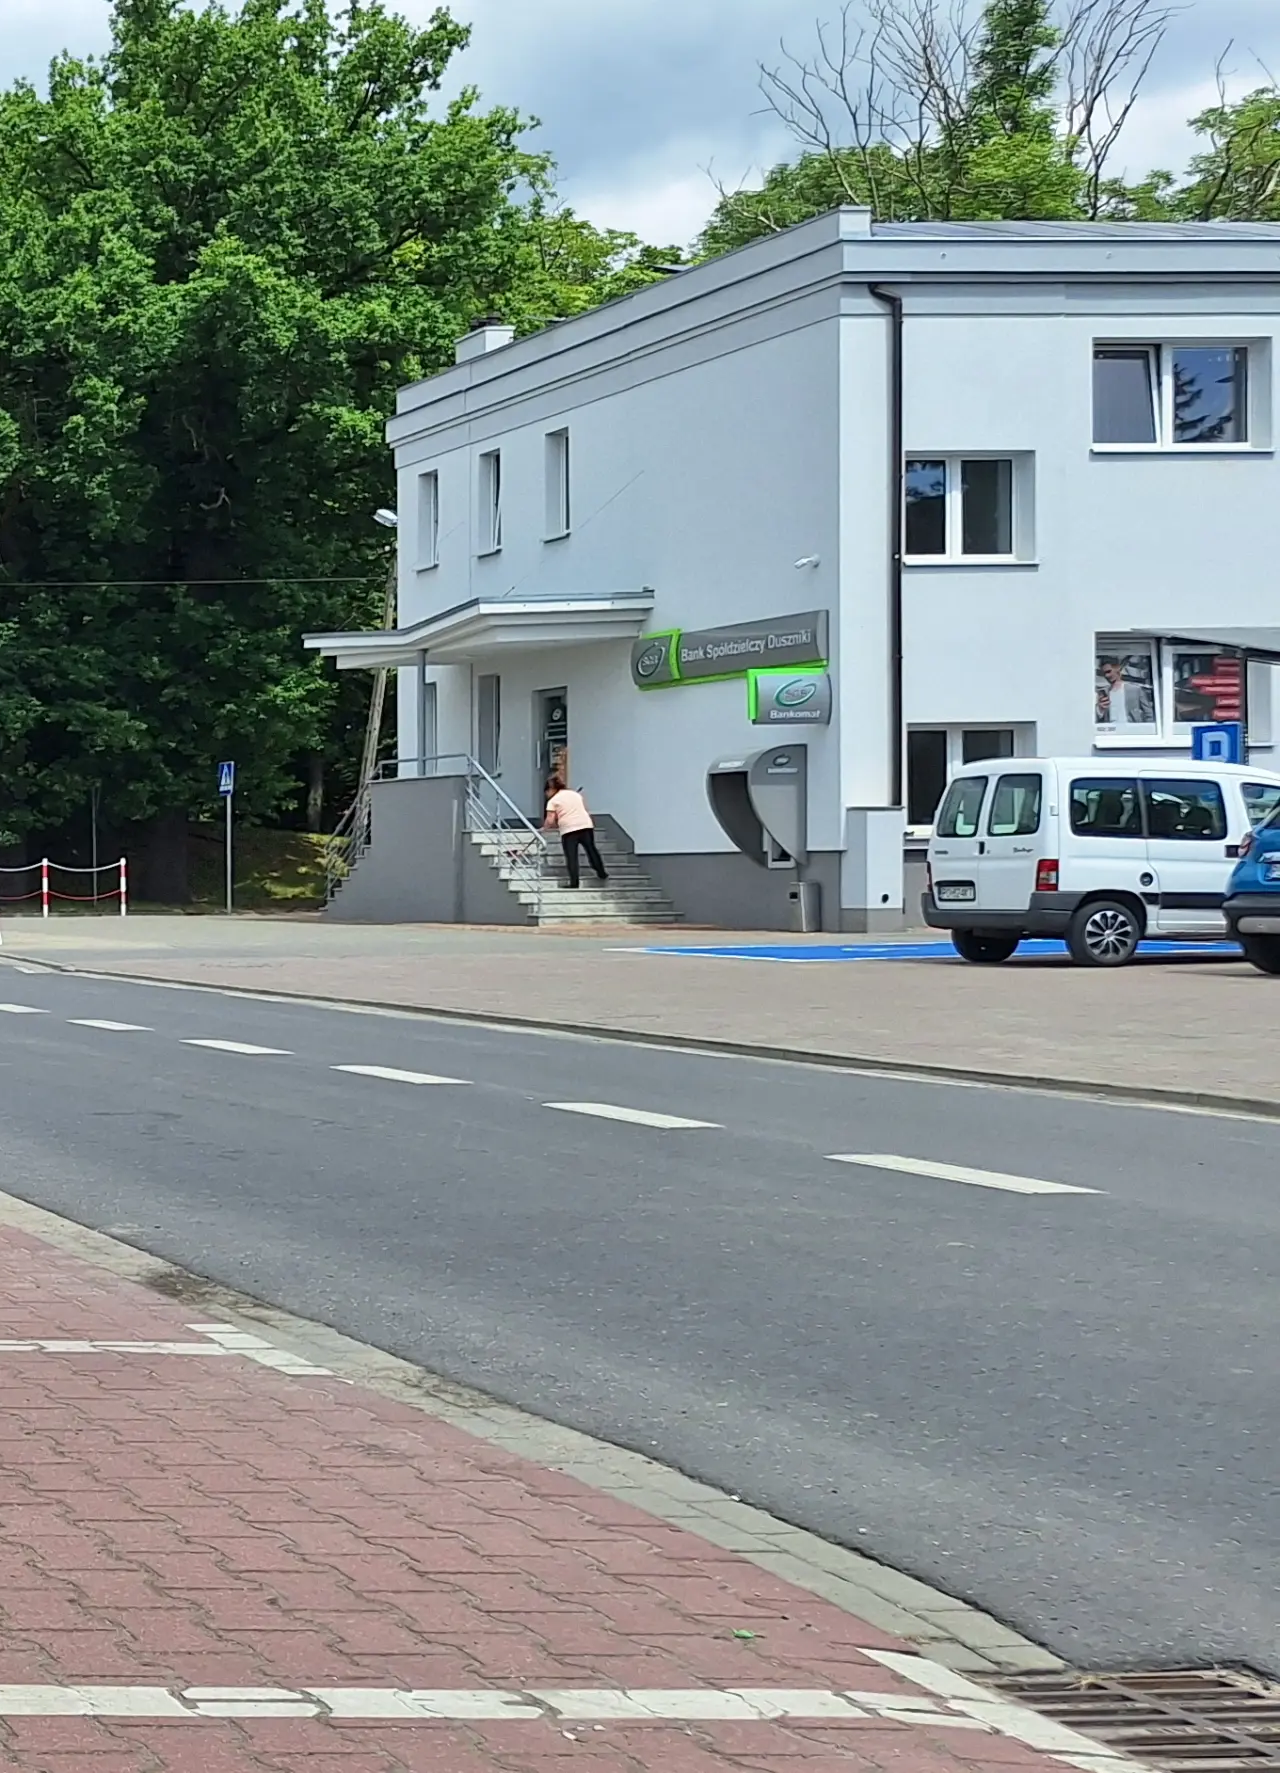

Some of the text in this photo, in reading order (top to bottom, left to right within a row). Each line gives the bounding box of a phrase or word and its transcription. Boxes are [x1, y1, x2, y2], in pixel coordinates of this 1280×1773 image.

[681, 646, 705, 662] Bank
[767, 629, 811, 648] Duszniki
[770, 709, 821, 720] Bankomat
